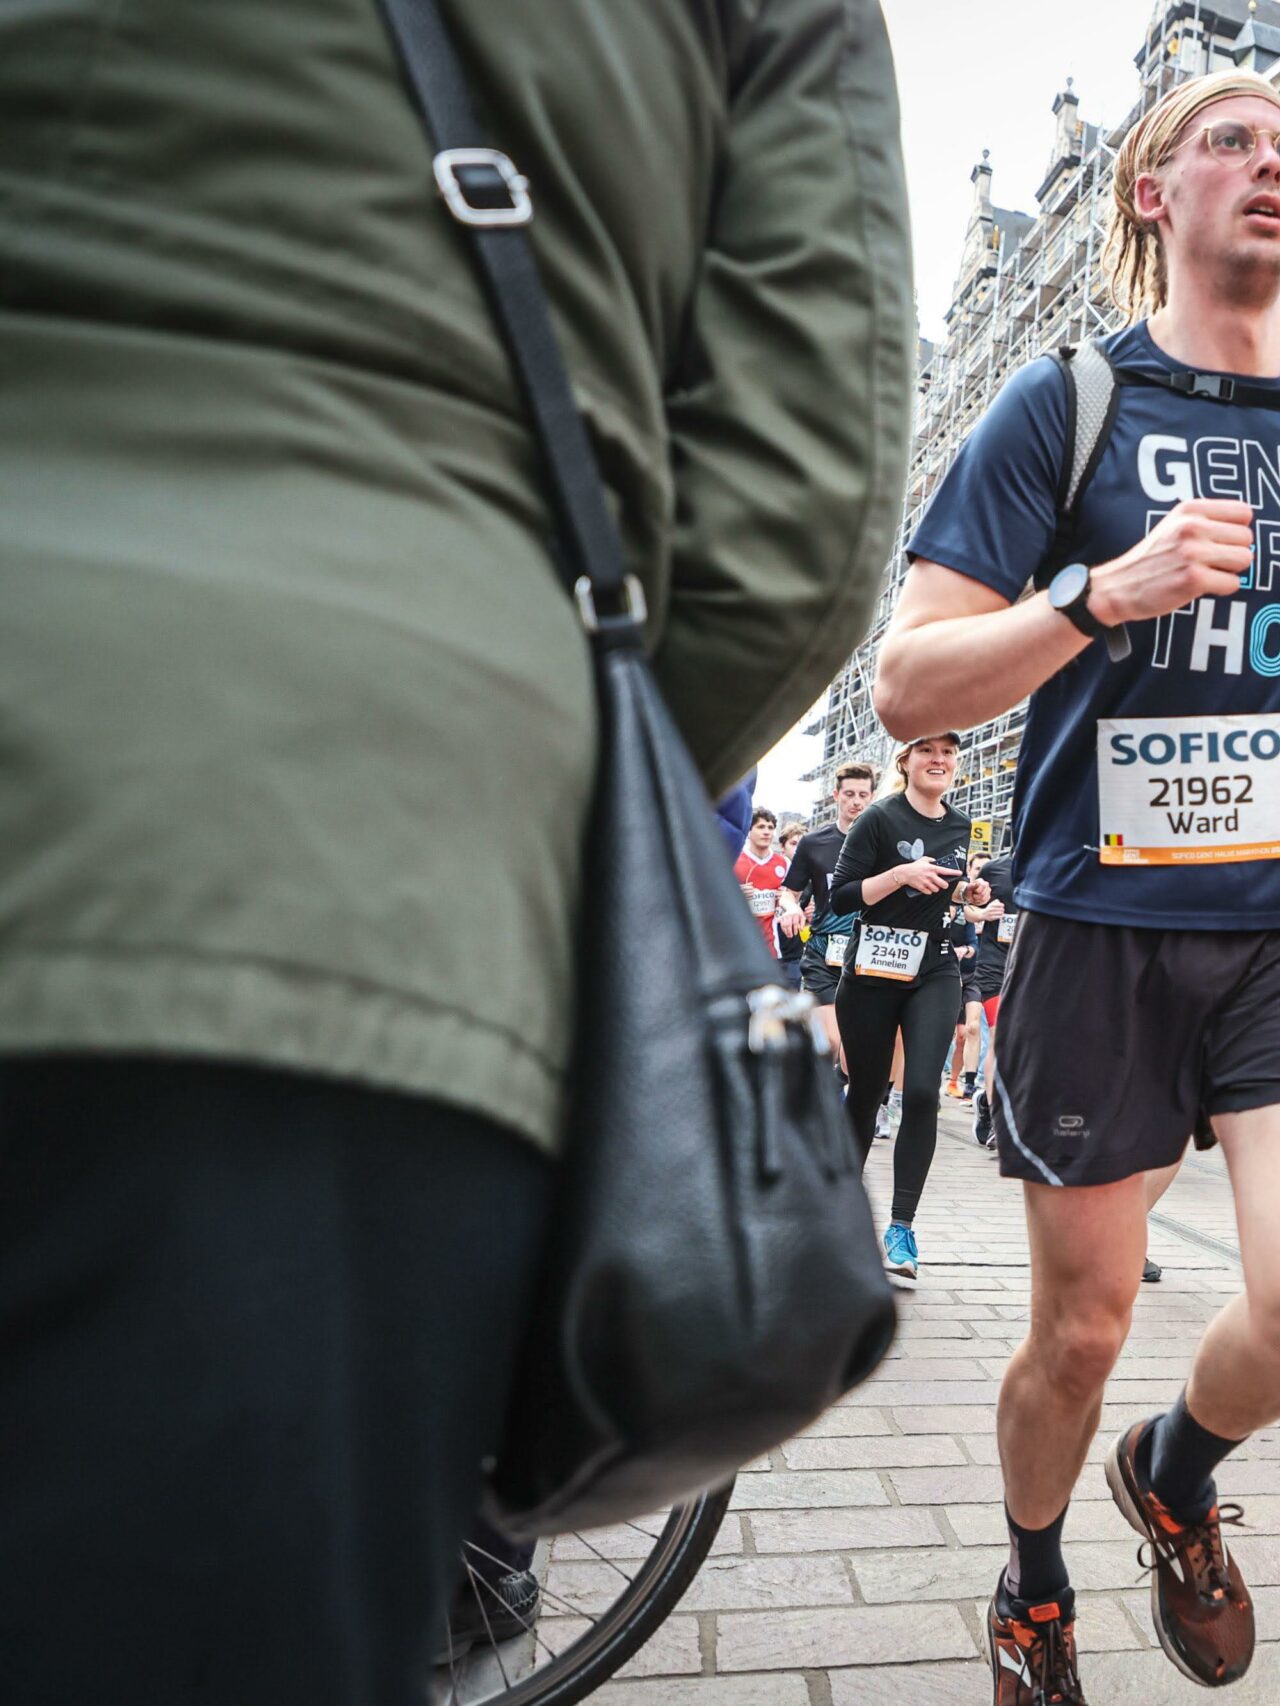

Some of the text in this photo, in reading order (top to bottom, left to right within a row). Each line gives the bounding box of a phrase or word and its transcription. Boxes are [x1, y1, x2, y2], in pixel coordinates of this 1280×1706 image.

[1148, 774, 1254, 808] 21962
[1166, 808, 1240, 835] Ward
[864, 930, 922, 947] SOFICO
[871, 945, 909, 960] 23419
[870, 957, 907, 970] Annelien
